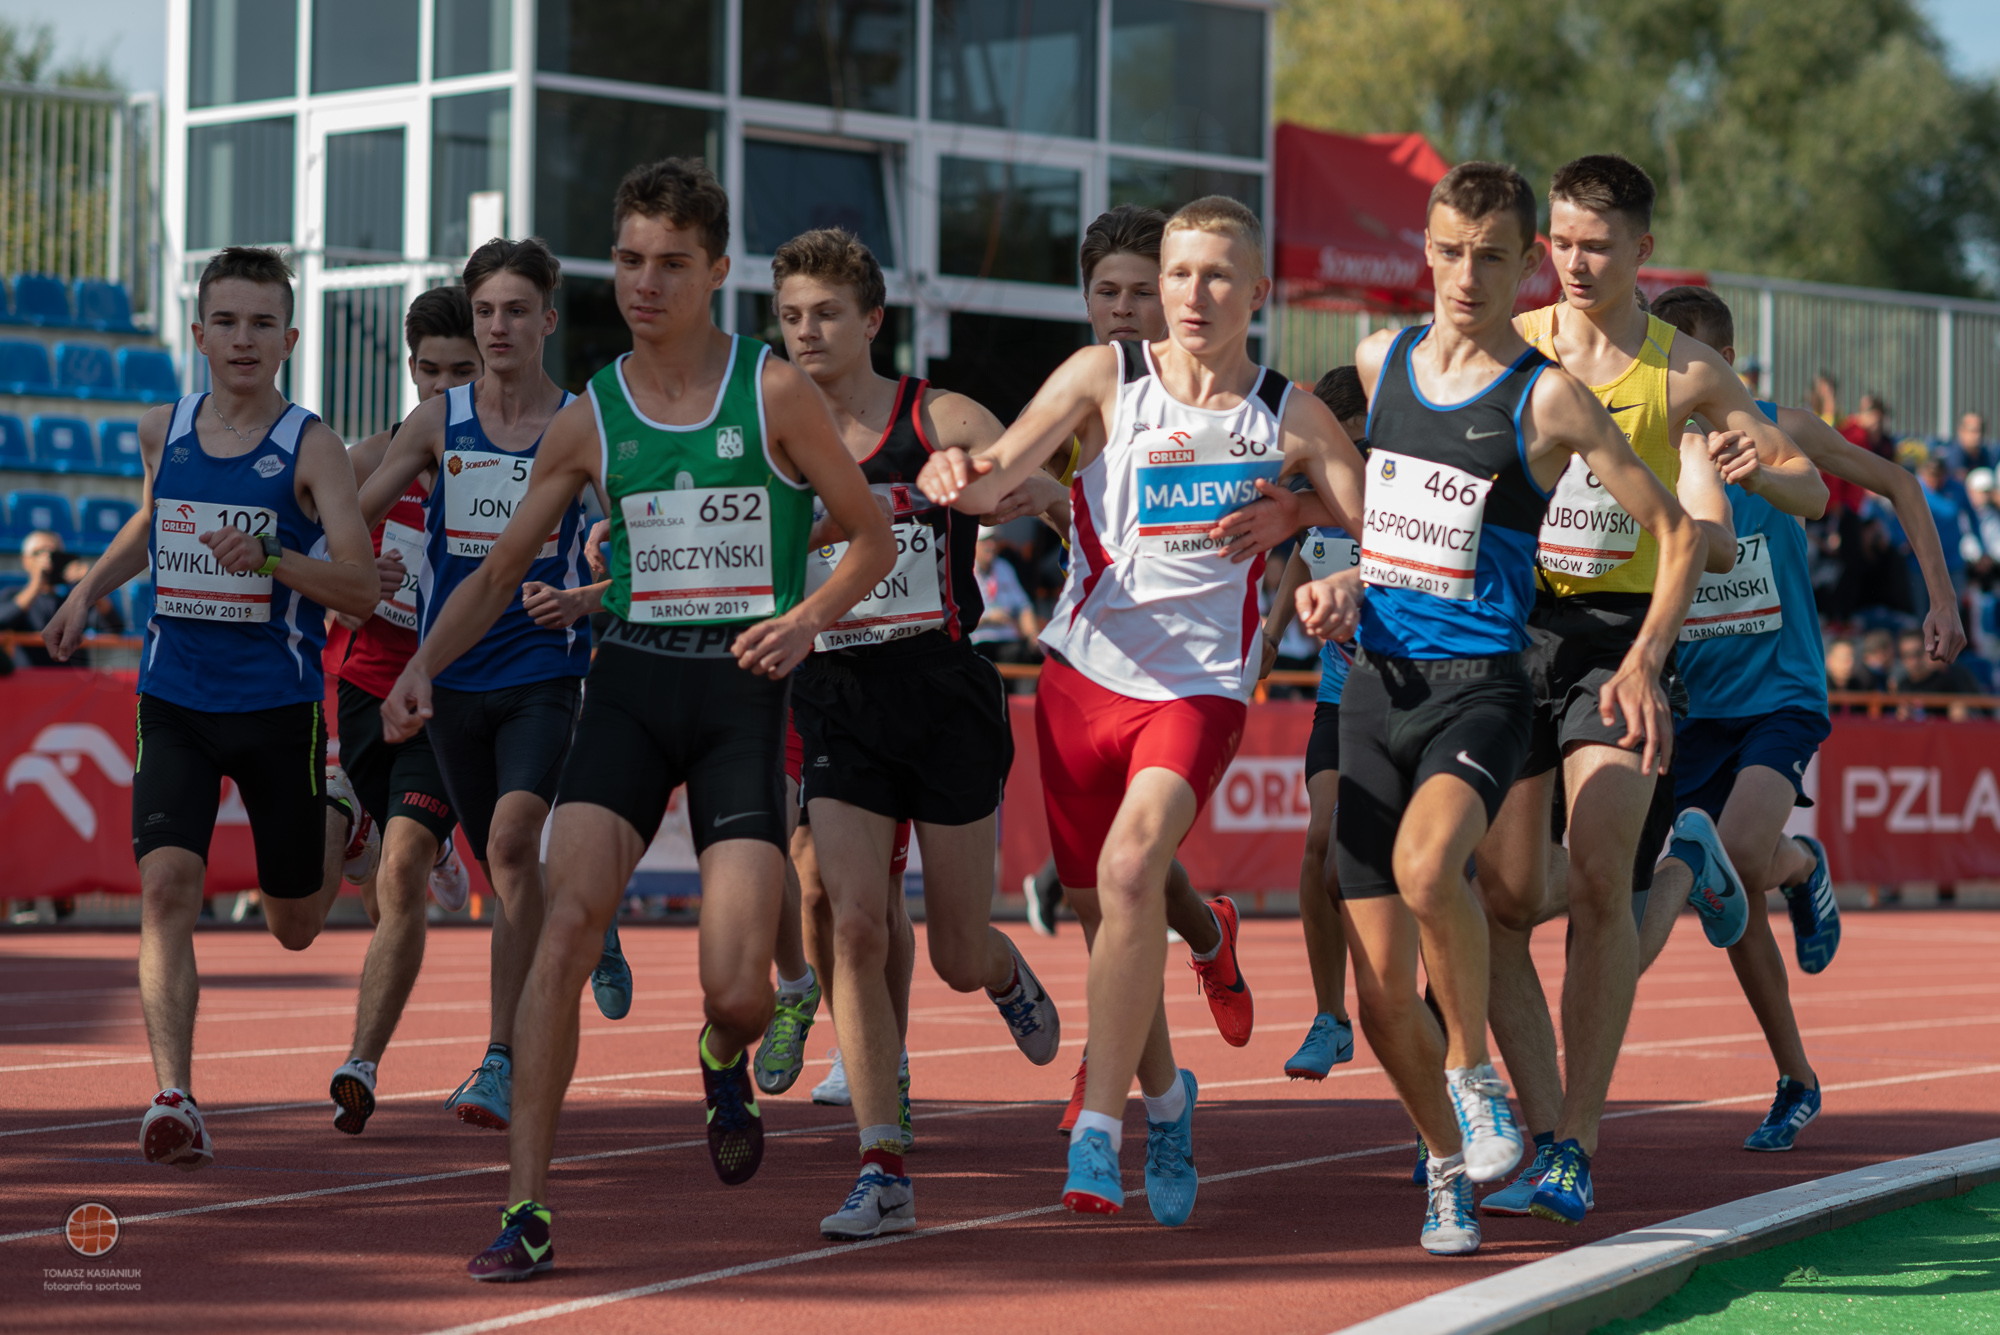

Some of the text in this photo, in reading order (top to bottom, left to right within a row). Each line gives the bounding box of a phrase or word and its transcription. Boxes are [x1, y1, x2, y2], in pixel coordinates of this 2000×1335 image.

[1150, 431, 1268, 463] ORLEN 36
[464, 457, 501, 470] SOKOŁÓW
[1144, 478, 1273, 510] MAJEWS
[1424, 470, 1479, 506] 466
[469, 498, 522, 519] JON
[699, 493, 762, 523] 652
[1541, 506, 1635, 535] UBOWSKI
[163, 509, 271, 537] ORLEN 102
[629, 517, 685, 529] MAŁOPOLSKA
[1363, 507, 1477, 552] ASPROWICZ
[459, 541, 495, 555] TARN
[635, 540, 765, 573] GÓRCZYŃSKI
[1164, 534, 1226, 553] TARNÓW
[156, 545, 270, 578] ĆWIKLI
[1541, 556, 1583, 573] RNÓW
[1362, 562, 1412, 586] ARNÓW
[1416, 576, 1450, 594] 2019
[1689, 577, 1770, 605] ZCIŃSKI
[164, 600, 252, 619] TARNÓW 2019
[383, 605, 417, 627] TARNÓ
[651, 600, 750, 618] TARNÓW 2019
[607, 622, 691, 653] NIKE
[828, 625, 922, 648] TARNÓW 2019
[1687, 622, 1737, 640] TARNÓW
[1738, 619, 1766, 634] 2019
[1429, 658, 1491, 682] PRO
[402, 791, 449, 818] TRUSO
[1228, 771, 1310, 816] ORL
[1842, 767, 2000, 834] PZLA
